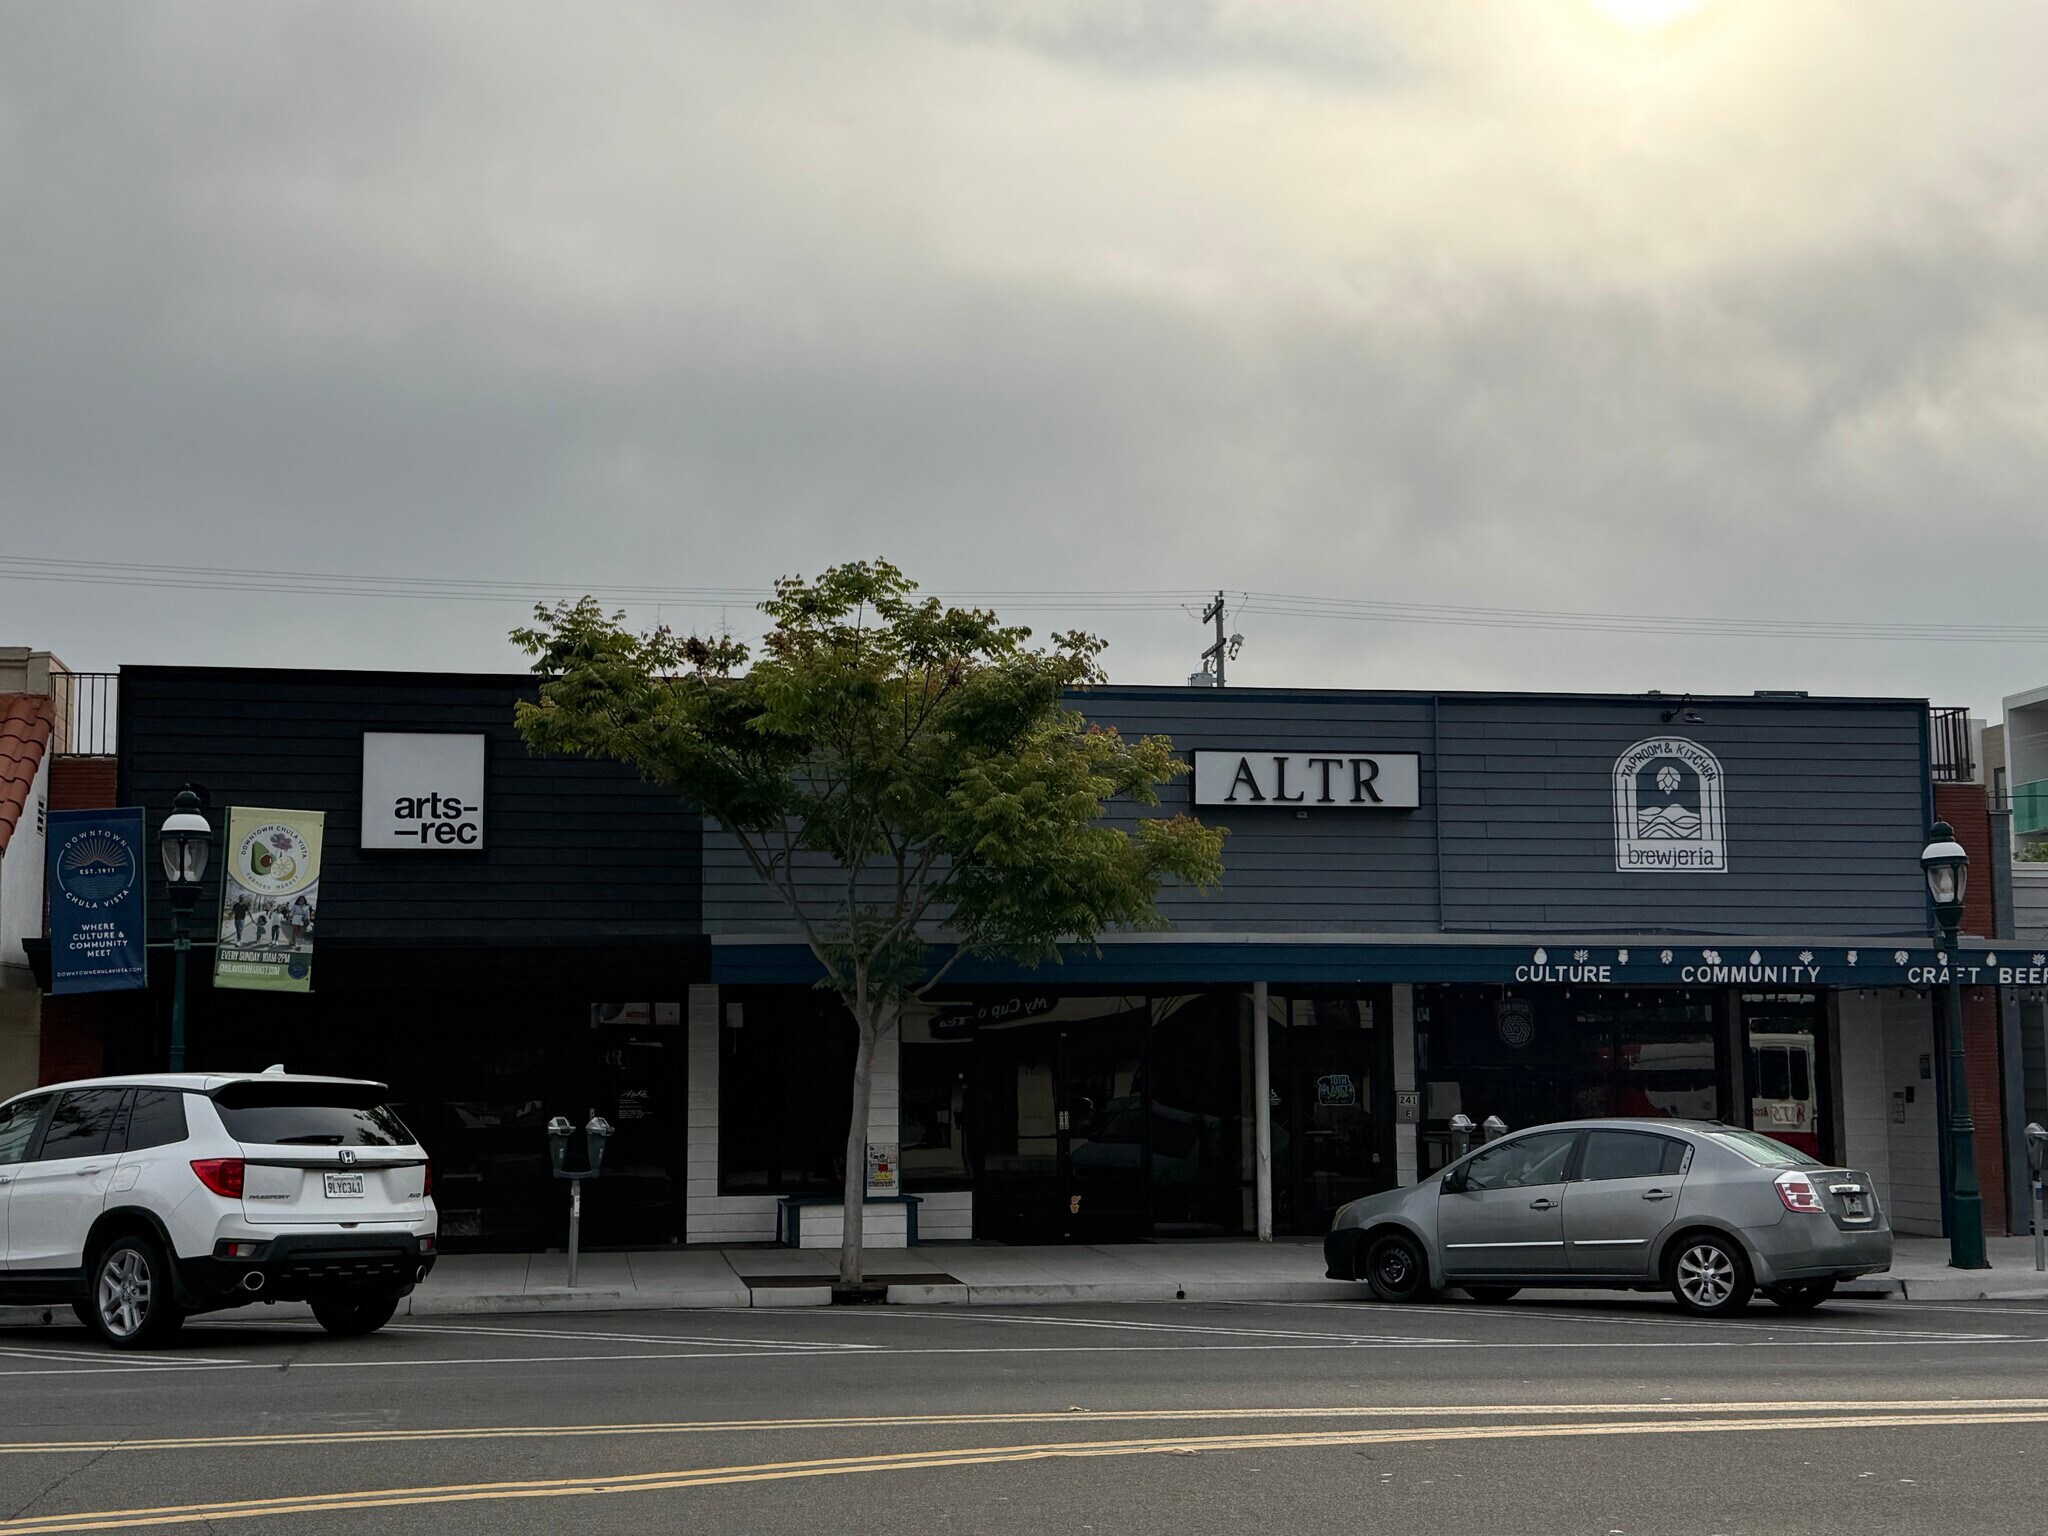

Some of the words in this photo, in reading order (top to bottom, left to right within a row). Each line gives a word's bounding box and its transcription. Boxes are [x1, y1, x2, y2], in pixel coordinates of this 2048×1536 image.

[1621, 742, 1663, 778] TAPROOM
[1664, 742, 1673, 754] &
[1675, 743, 1717, 783] KITCHEN
[1224, 756, 1384, 802] ALTR
[65, 830, 128, 849] DOWNTOWN
[241, 826, 274, 856] DOWNTOWN
[276, 825, 298, 840] CHULA
[298, 839, 308, 859] VISTA
[1627, 843, 1715, 868] brewjería
[246, 873, 272, 891] FARMERS
[275, 875, 300, 891] MARKET
[65, 892, 98, 909] CHULA
[103, 889, 130, 908] VISTA
[72, 931, 115, 941] CULTURE
[118, 931, 125, 939] &
[81, 922, 116, 932] WHERE
[69, 940, 129, 950] COMMUNITY
[87, 949, 112, 958] MEET
[221, 950, 240, 960] EVERY
[239, 951, 261, 962] SUNDAY
[1515, 965, 1611, 983] CULTURE
[1681, 965, 1821, 983] COMMUNITY
[1400, 1096, 1416, 1105] 241
[1405, 1110, 1411, 1118] E
[327, 1182, 361, 1194] 9LYC341
